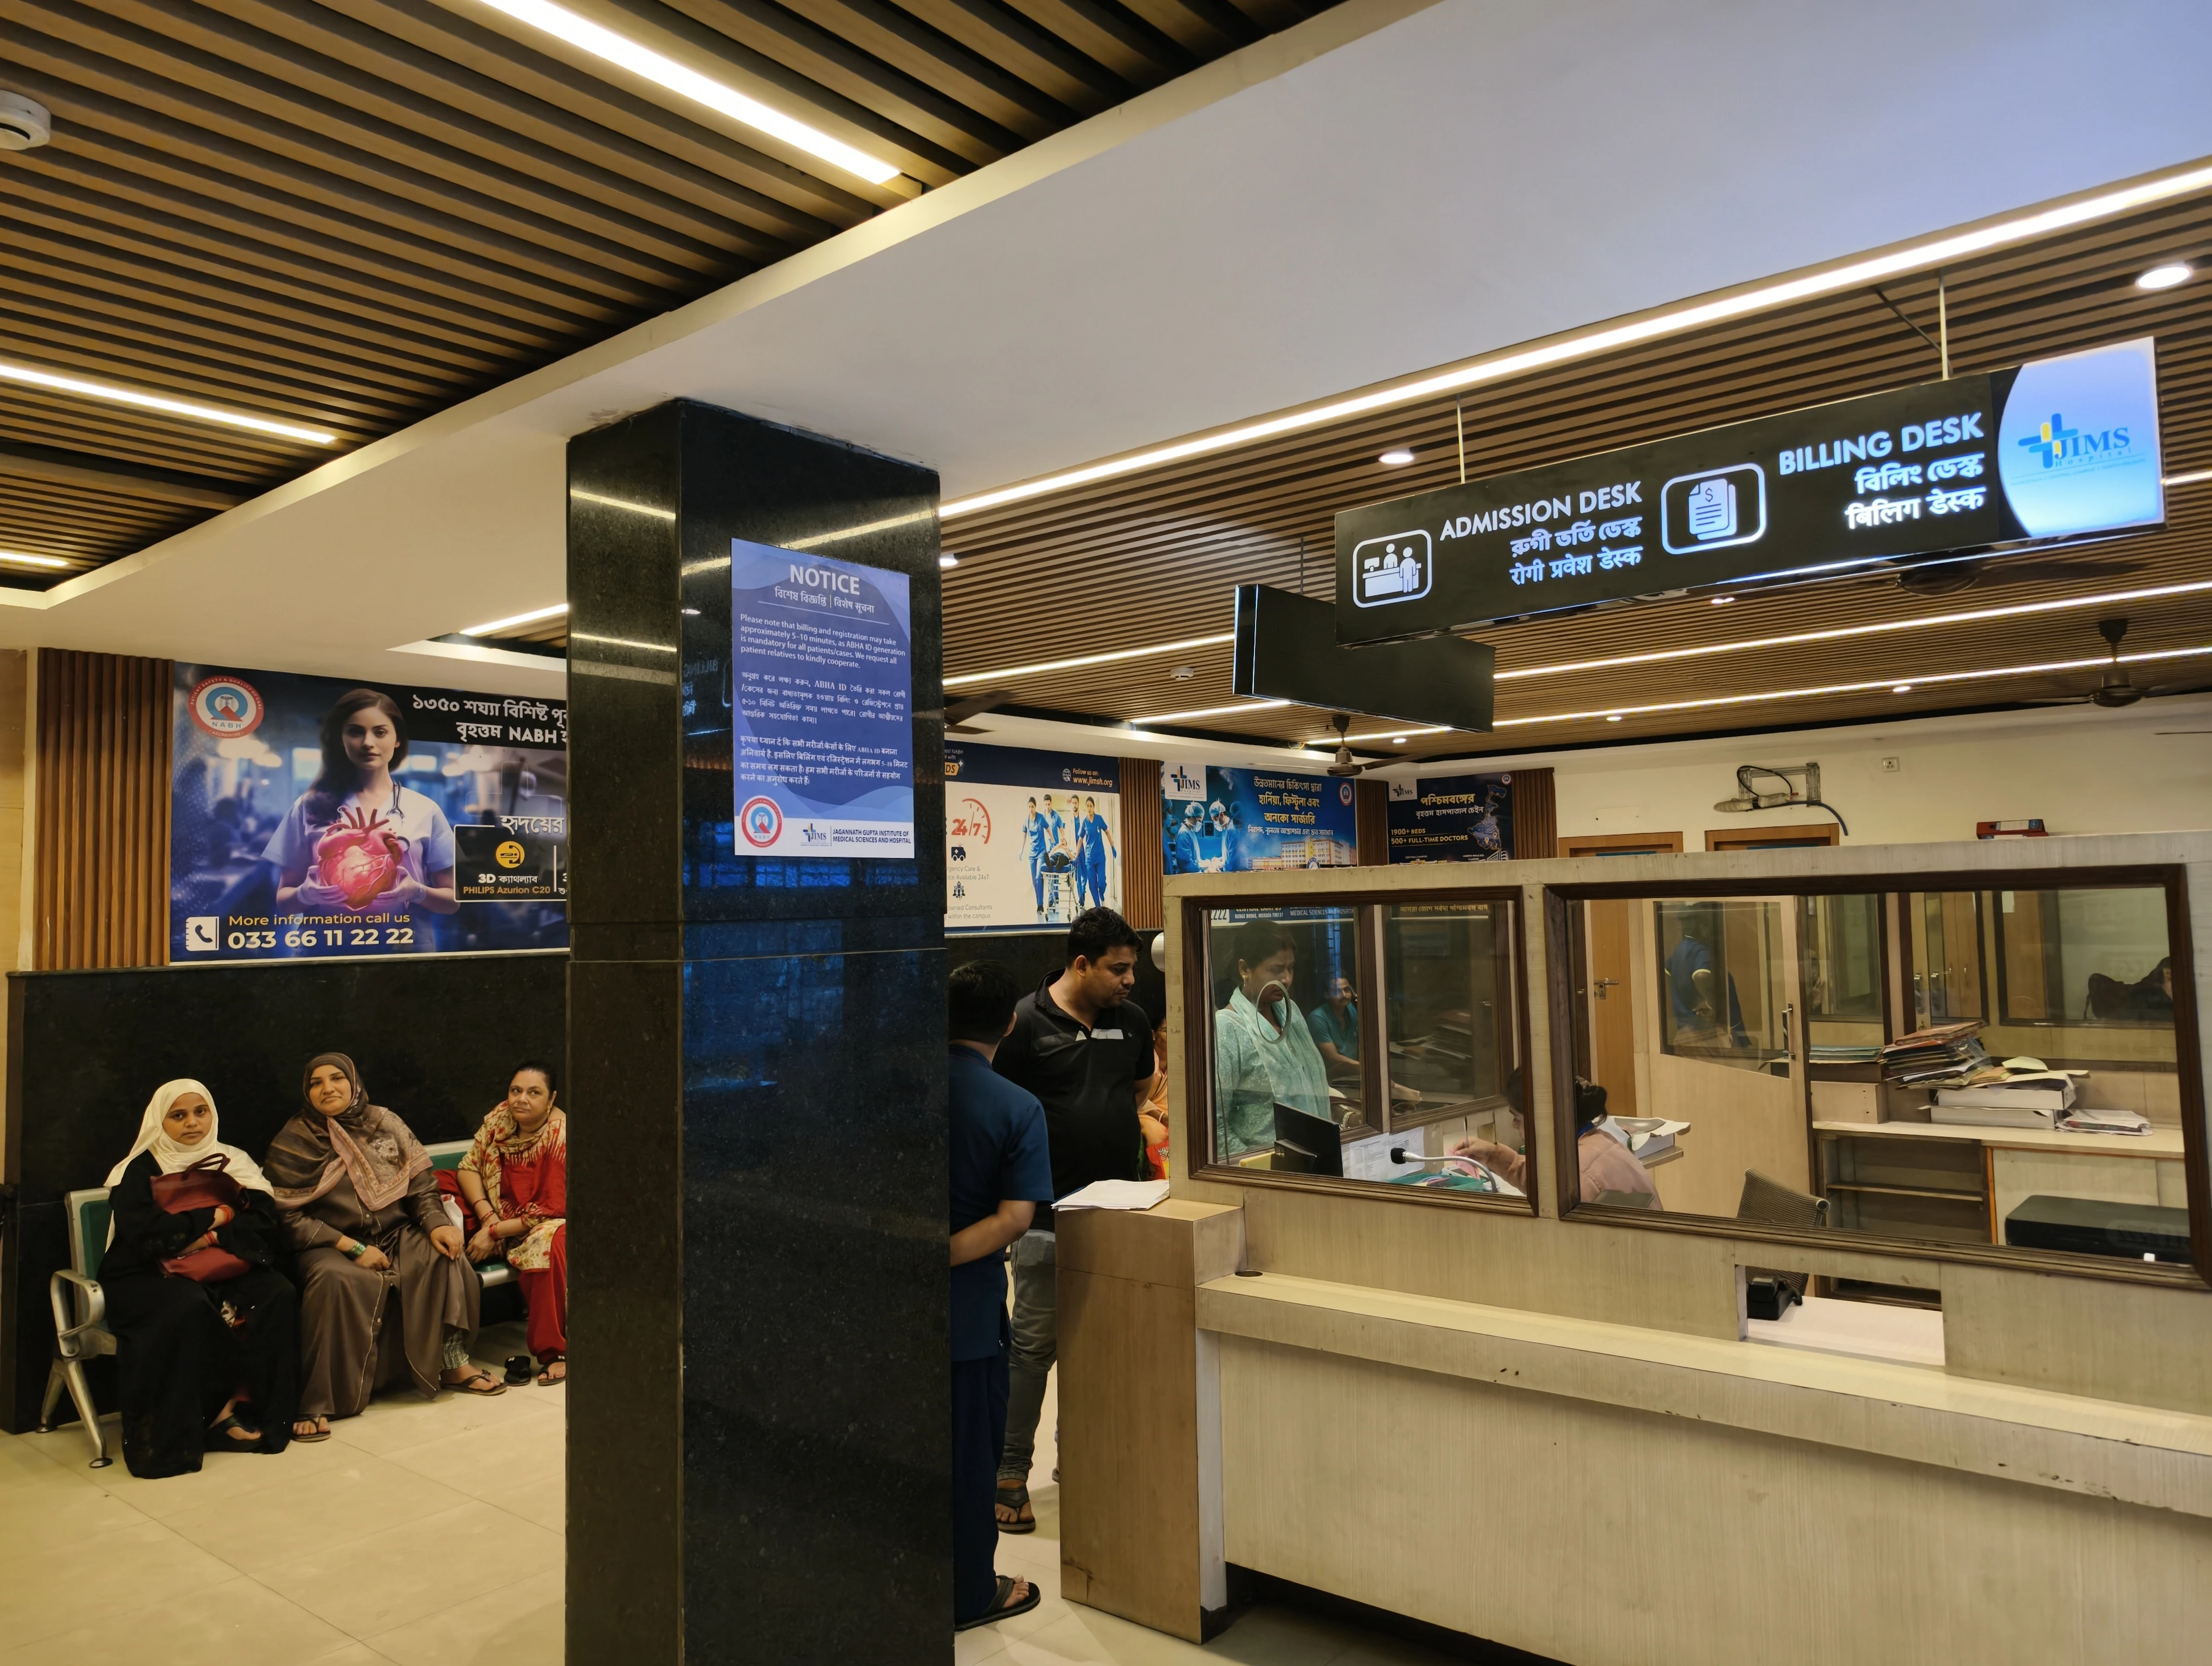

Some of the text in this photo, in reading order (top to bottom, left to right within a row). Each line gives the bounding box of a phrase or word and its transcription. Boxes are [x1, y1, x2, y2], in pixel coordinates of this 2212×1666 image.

[1779, 412, 1984, 476] BILLING DESK
[2054, 427, 2130, 459] JIMS
[2055, 447, 2131, 467] Hospital
[1854, 462, 1922, 494] বিলিং
[1927, 452, 1985, 482] ডেস্ক
[1439, 480, 1642, 541] ADMISSION DESK
[1925, 485, 1986, 515] डेस्क
[1510, 516, 1643, 558] রুগী ভর্তি ডেস্ক
[1509, 546, 1643, 585] रोगी प्रवेश डेस्क
[790, 564, 860, 595] NOTICE
[774, 586, 799, 601] বিশেষ
[834, 596, 874, 614] विशेष सूचना
[740, 613, 763, 624] Please
[764, 619, 780, 627] note
[781, 620, 795, 629] that
[796, 622, 818, 635] billing
[832, 630, 868, 641] registration
[869, 636, 882, 645] may
[883, 637, 896, 645] take
[740, 625, 790, 640] approximately
[809, 636, 837, 646] minutes,
[846, 640, 864, 650] ABHA
[873, 646, 905, 656] generation
[741, 633, 747, 642] is
[748, 637, 786, 649] mandatory
[787, 640, 796, 649] for
[807, 645, 854, 658] patients/cases.
[854, 651, 865, 659] We
[866, 655, 889, 663] request
[741, 646, 766, 655] patient
[767, 649, 796, 659] relatives
[806, 653, 826, 665] kindly
[827, 658, 860, 668] cooperate.
[741, 671, 760, 681] অনুগ্রহ
[814, 680, 835, 690] ABHA
[839, 683, 846, 691] ID
[850, 684, 862, 693] তৈরি
[893, 690, 905, 698] রোগী
[413, 694, 460, 712] ১৩৫০
[463, 700, 501, 716] শয্যা
[503, 699, 549, 722] বিশিষ্ট
[768, 712, 798, 721] সহযোগিতা
[456, 722, 503, 742] বৃহত্তম
[509, 726, 556, 744] NABH
[779, 764, 798, 772] सकता
[815, 765, 828, 774] सभी
[828, 766, 847, 776] मरीजों
[847, 767, 853, 776] के
[875, 770, 882, 778] से
[881, 771, 901, 780] सहयोग
[946, 765, 955, 773] DS
[1073, 777, 1113, 787] www.jimsh.org
[1180, 779, 1200, 791] JIMS
[1254, 777, 1322, 792] উন্নতমানের চিকিৎসা দ্বারা
[1283, 792, 1306, 811] ফিস্টুলা
[1307, 798, 1320, 808] এবং
[1420, 793, 1475, 806] পশ্চিমবঙ্গের
[1264, 811, 1315, 825] অনকো সার্জারি
[1416, 805, 1484, 819] বৃহত্তম হাসপাতাল চেইন
[478, 874, 538, 884] 3D ক্যাথল্যাব
[229, 913, 410, 926] More information call us
[228, 928, 414, 949] 033 66 11 22 22
